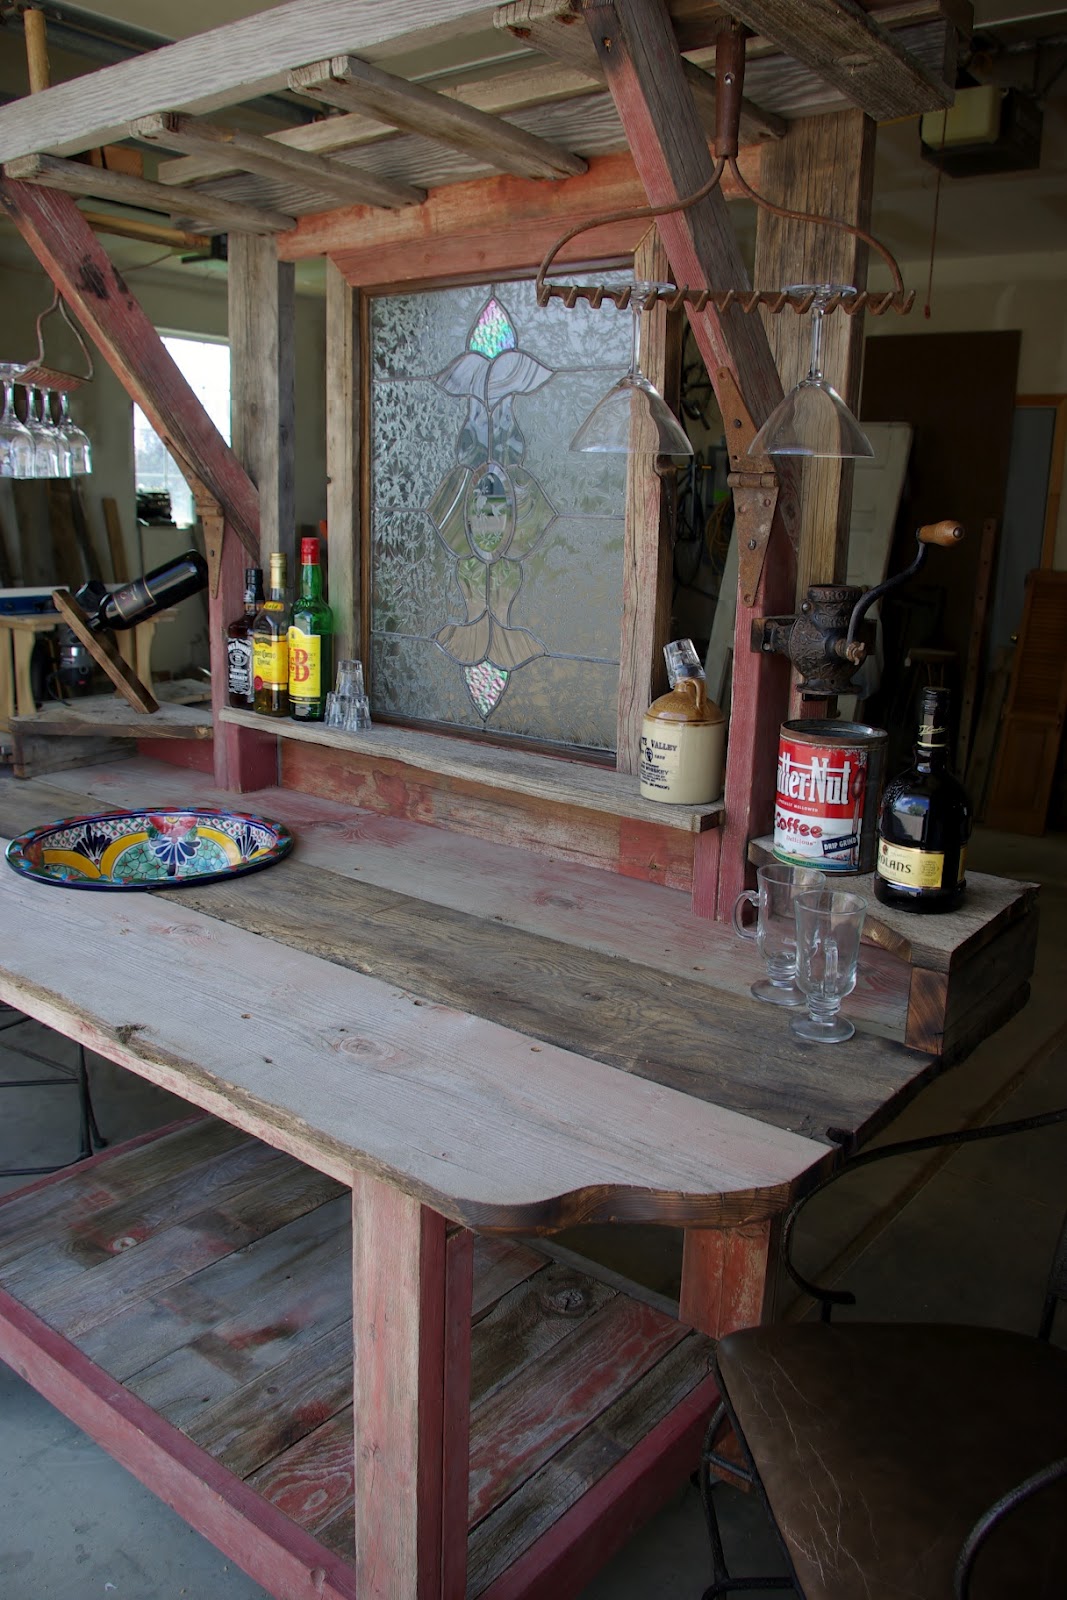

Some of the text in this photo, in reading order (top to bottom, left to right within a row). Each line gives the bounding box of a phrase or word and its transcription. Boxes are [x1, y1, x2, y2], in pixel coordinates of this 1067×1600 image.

[651, 739, 677, 751] VALLEY
[776, 811, 822, 838] Coffee
[824, 836, 857, 850] DRIP GRIND
